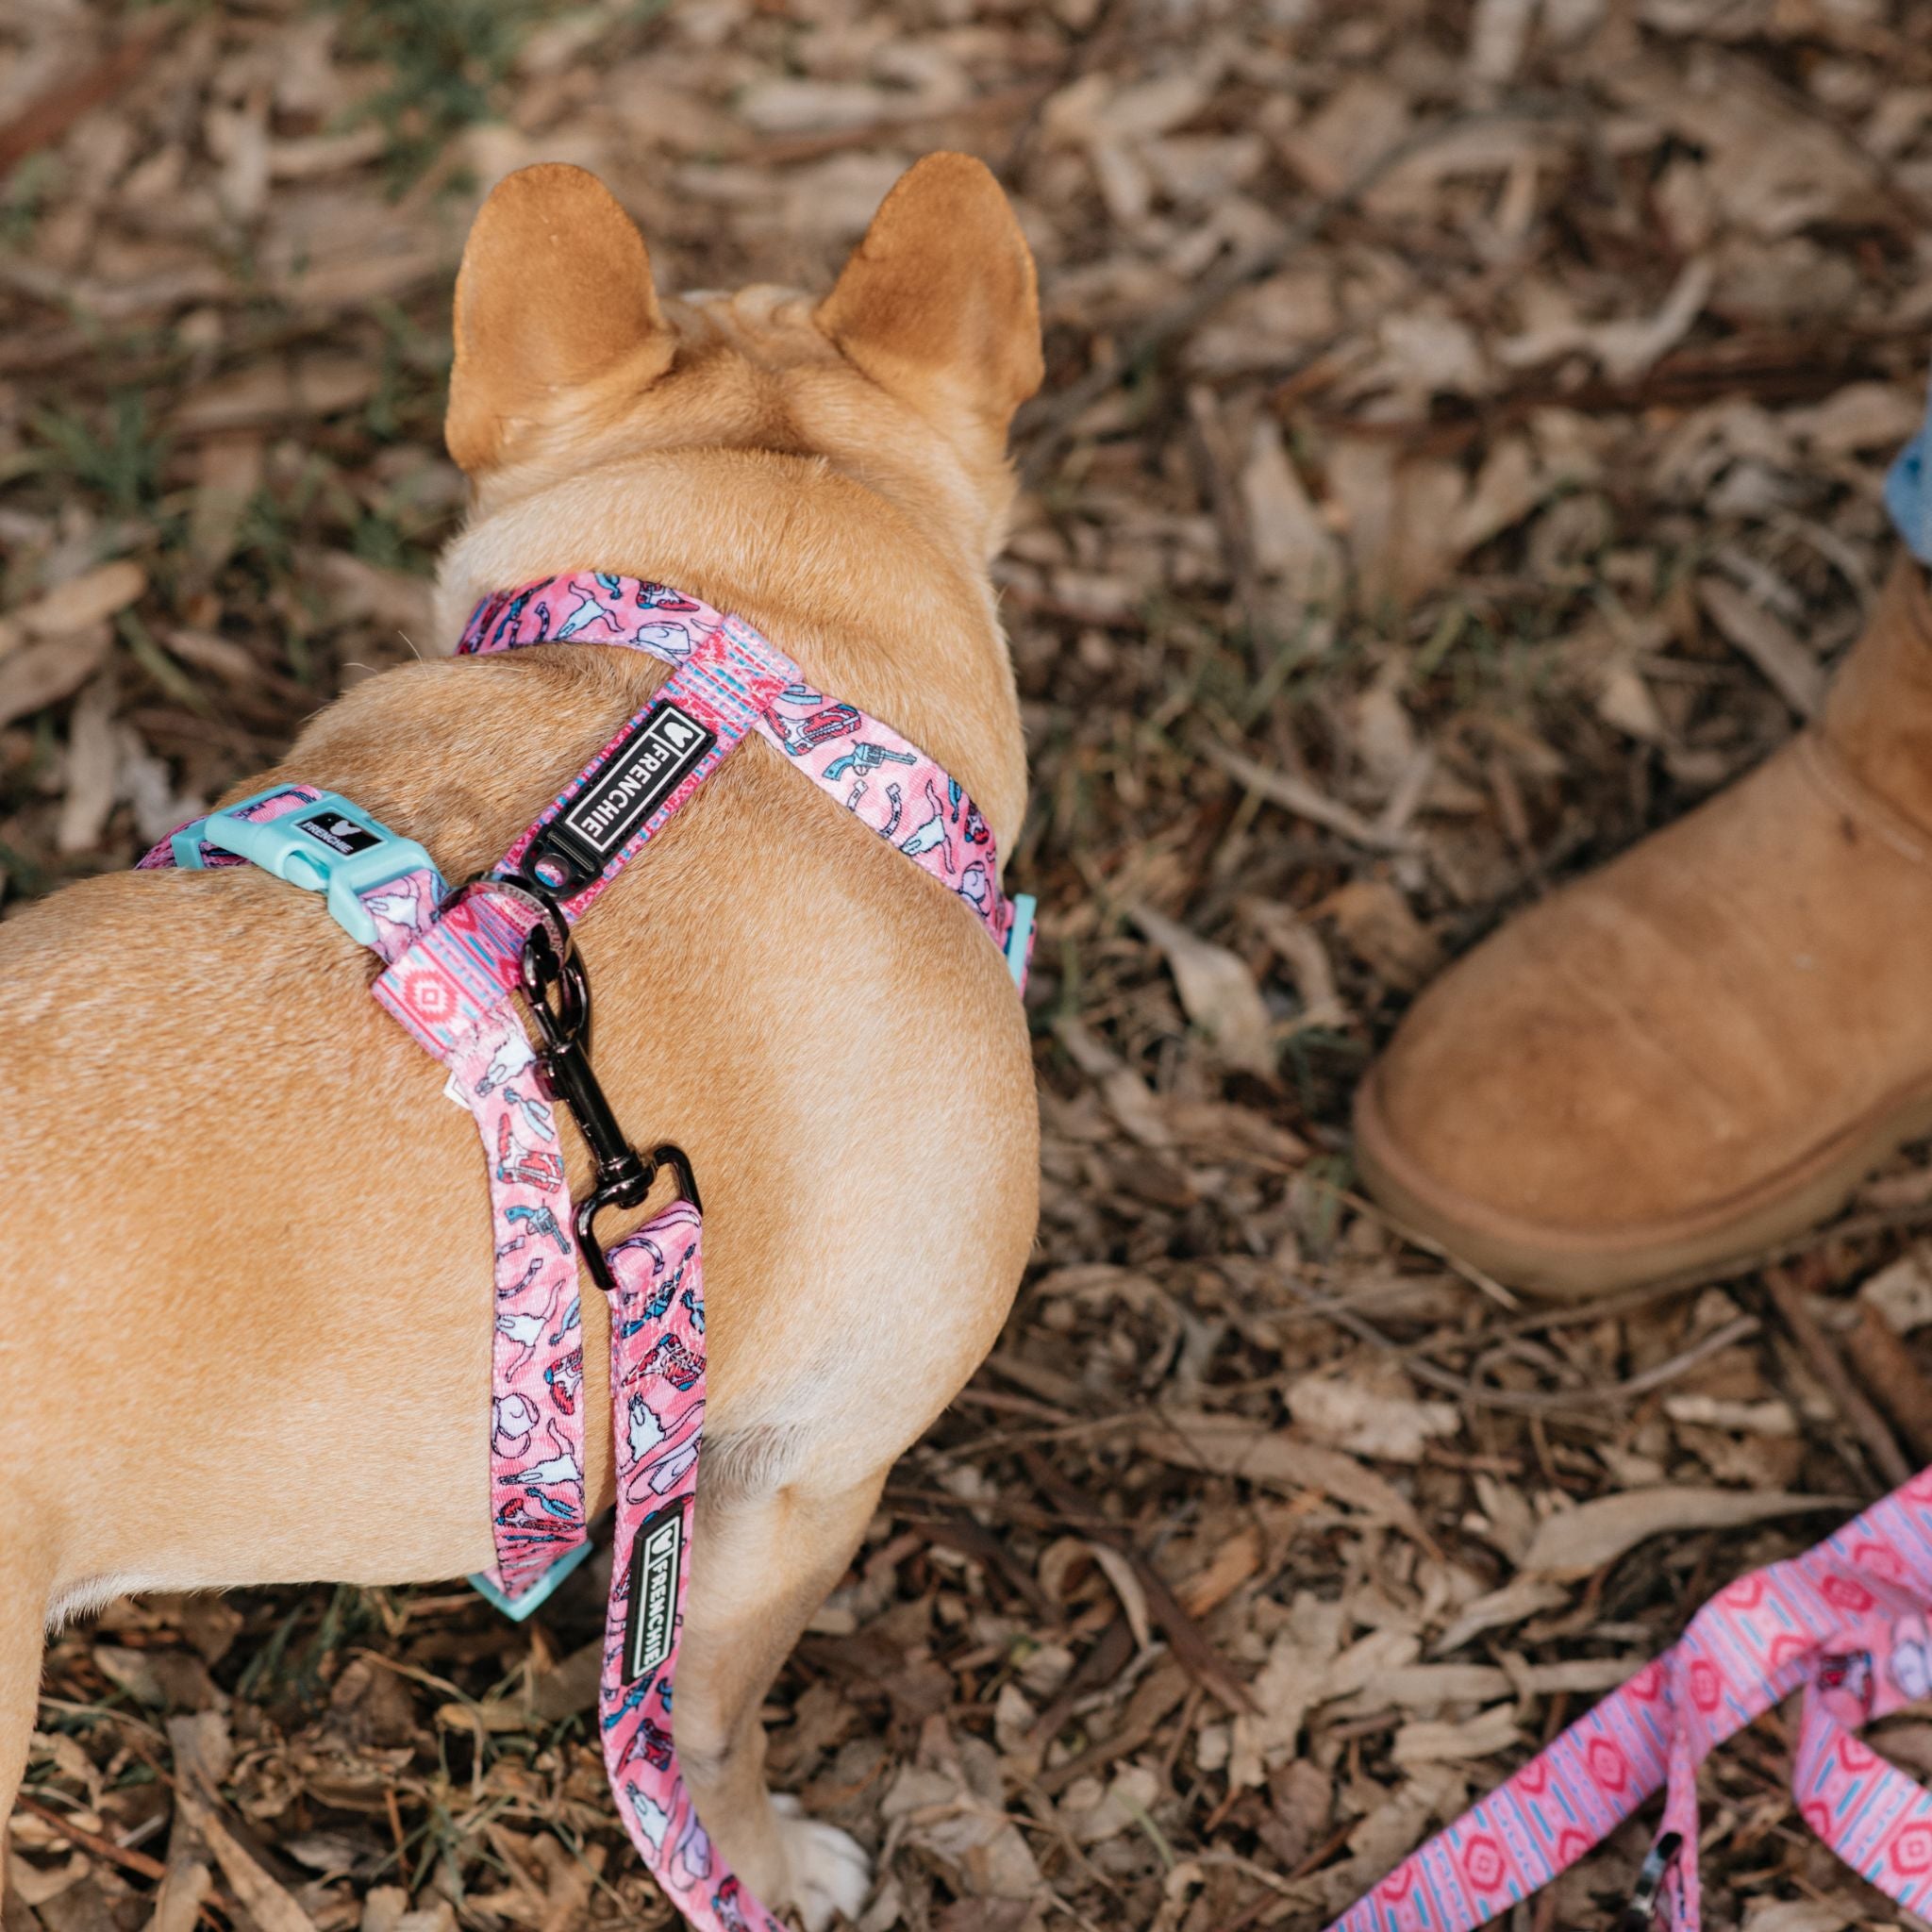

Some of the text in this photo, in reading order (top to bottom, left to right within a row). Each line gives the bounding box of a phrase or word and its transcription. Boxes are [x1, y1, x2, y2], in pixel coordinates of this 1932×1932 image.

[302, 821, 354, 853] FRENCHIE
[581, 742, 670, 838] FRENCHIE
[643, 1559, 669, 1666] FRENCHIE
